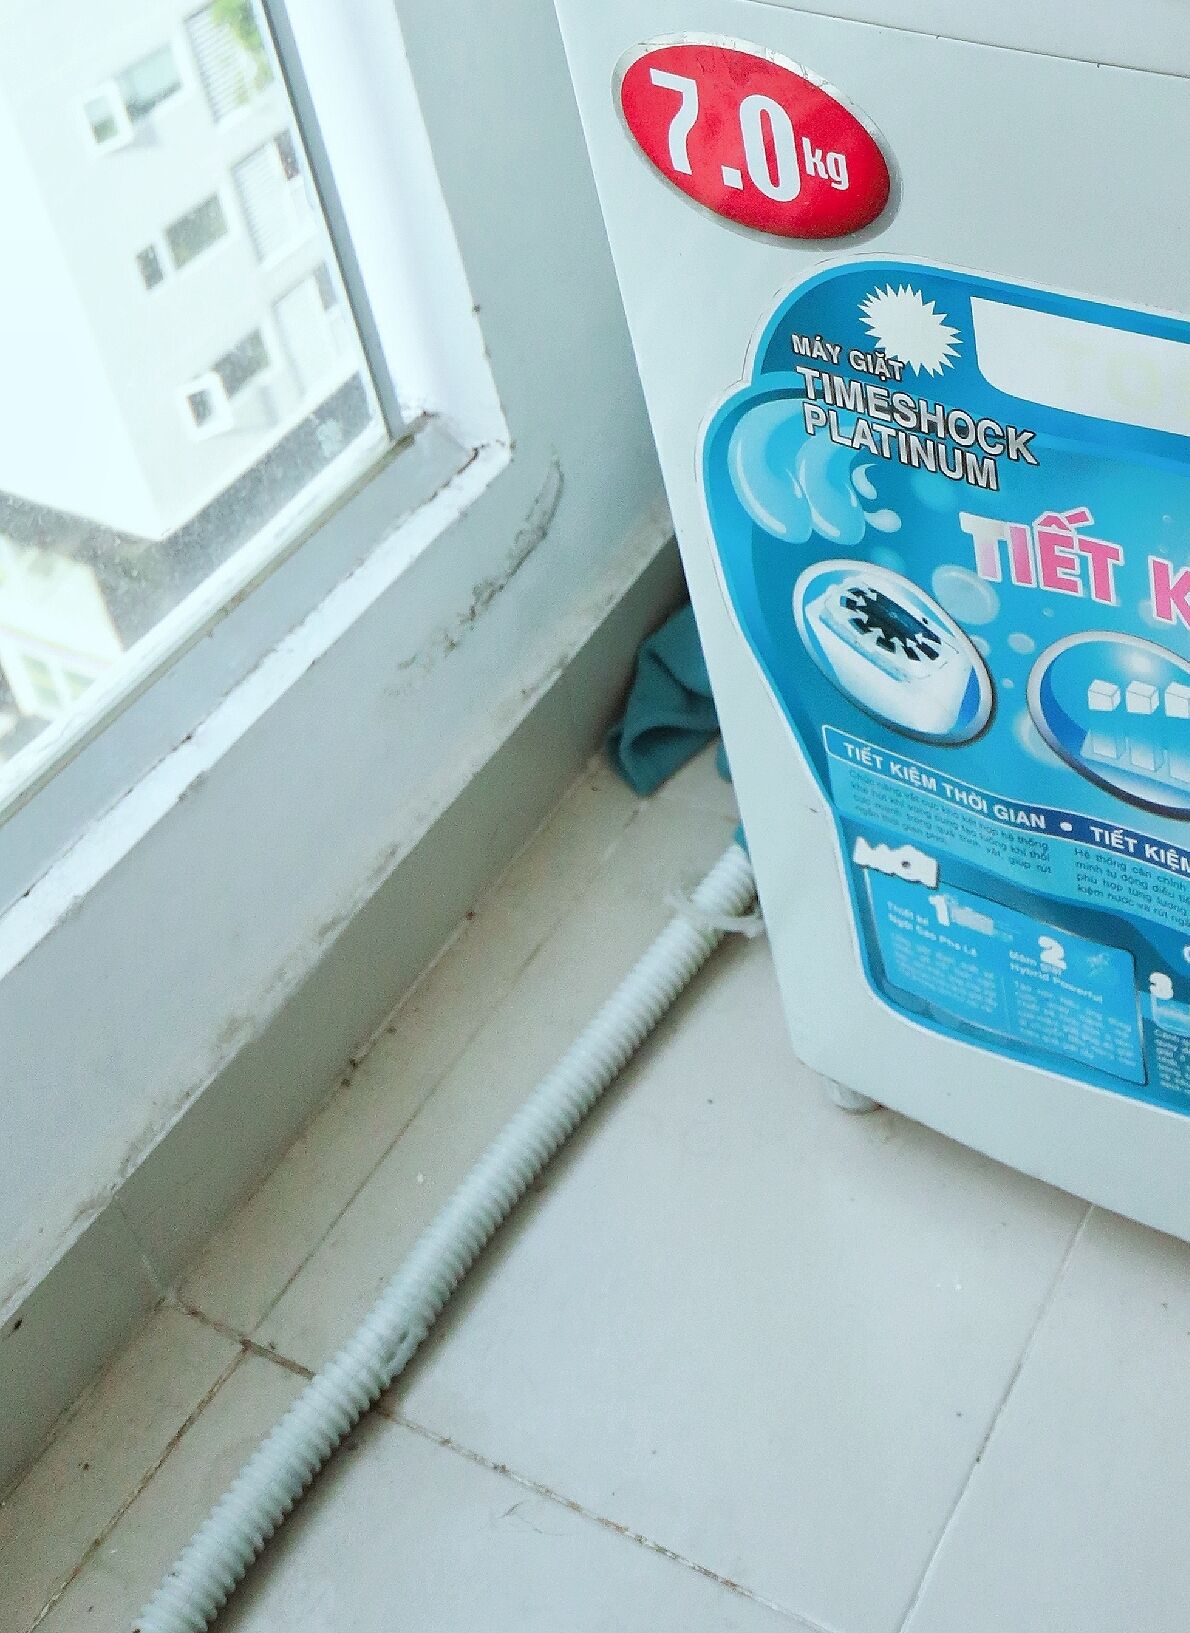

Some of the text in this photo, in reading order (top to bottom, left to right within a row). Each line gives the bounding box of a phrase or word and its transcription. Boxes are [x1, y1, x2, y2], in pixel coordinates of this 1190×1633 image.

[791, 332, 905, 382] MÁY GIẶT
[796, 365, 1040, 467] TIMESHOCK
[802, 401, 1000, 491] PLATINUM
[958, 506, 1123, 605] TIẾT
[842, 741, 884, 770] TIẾT
[889, 759, 938, 793] KIỆM
[942, 783, 989, 813] THỜI
[993, 804, 1046, 830] GIAN
[1090, 824, 1138, 854] TIẾT
[927, 894, 951, 927] 1
[1037, 935, 1067, 970] 2
